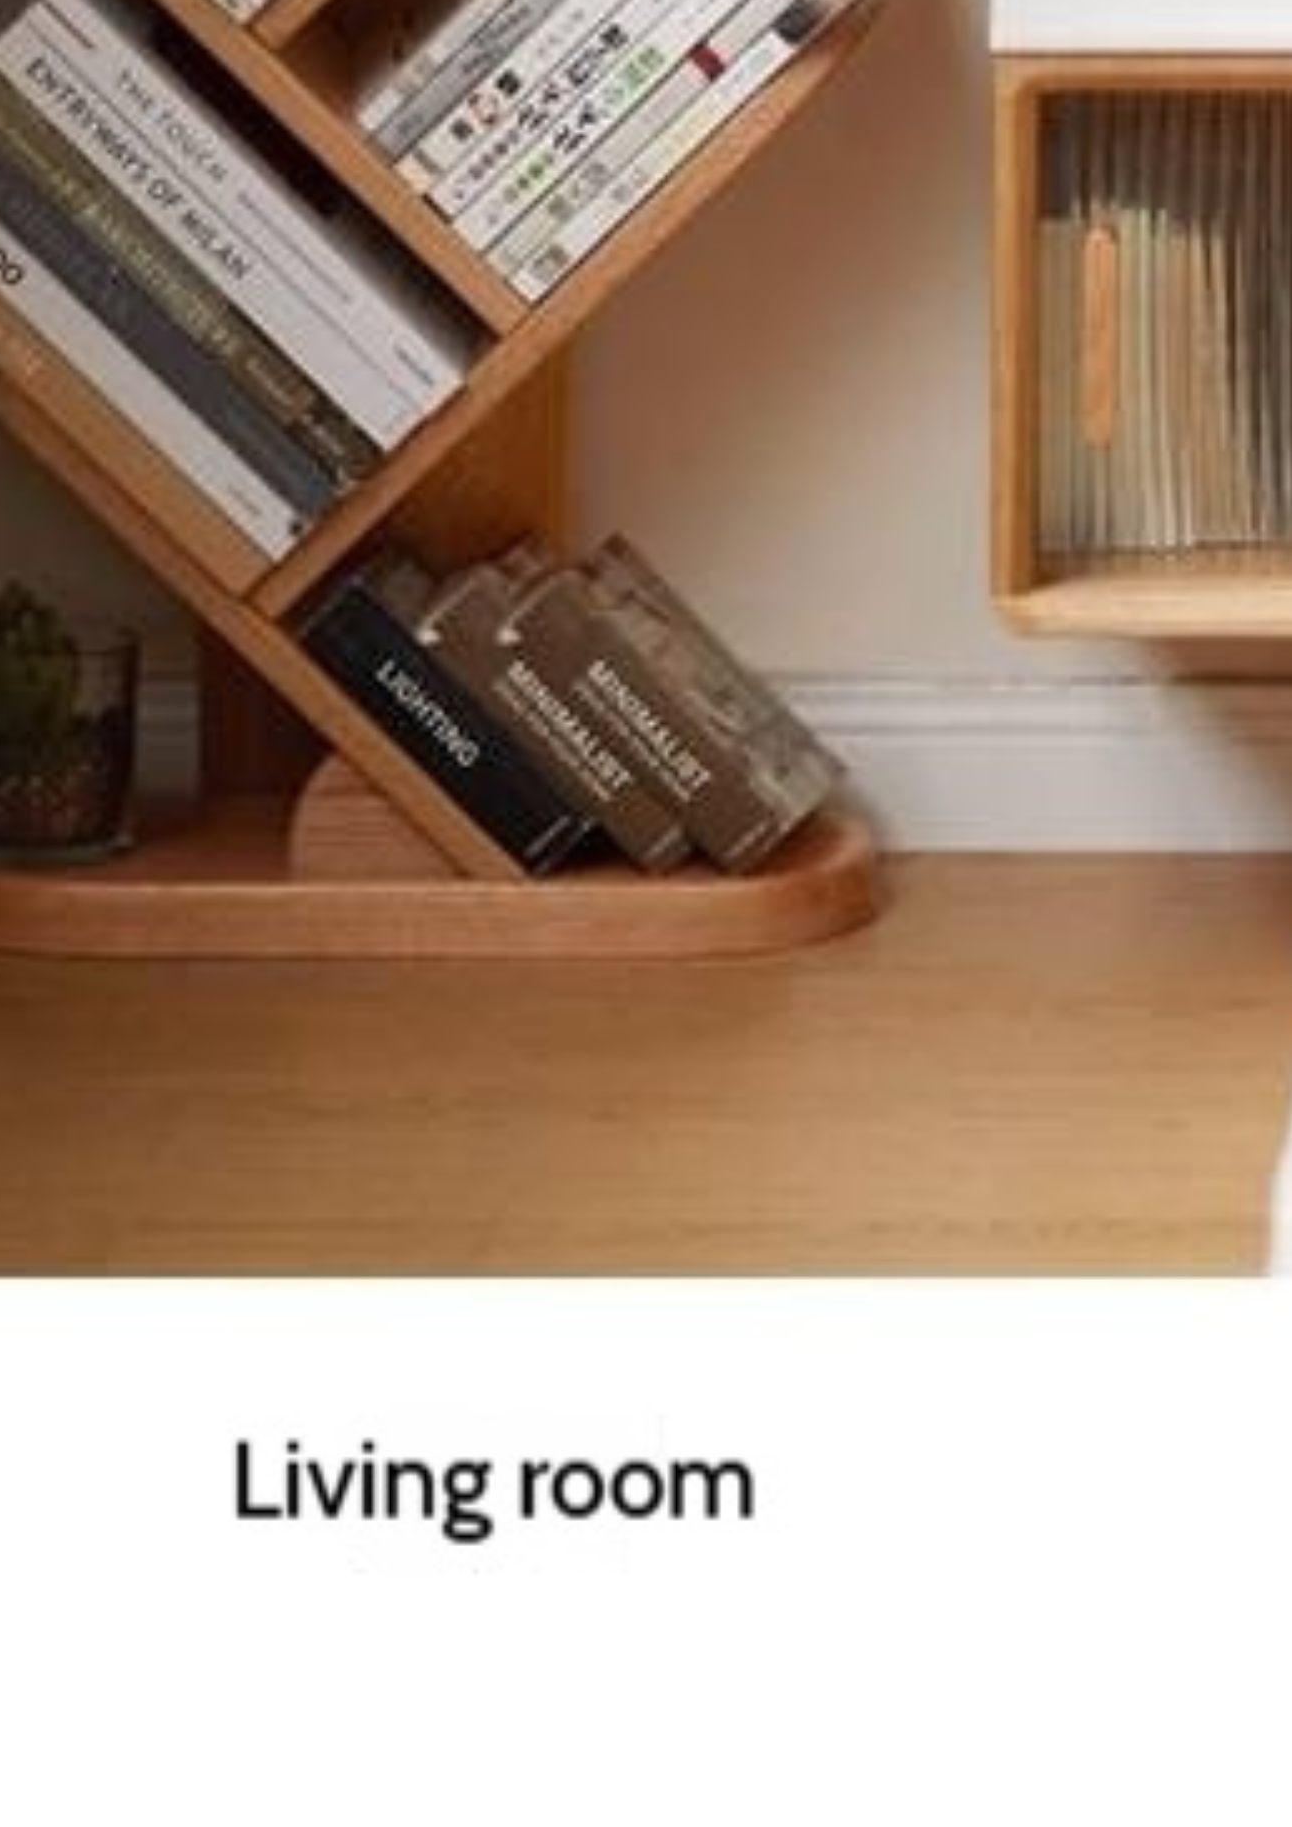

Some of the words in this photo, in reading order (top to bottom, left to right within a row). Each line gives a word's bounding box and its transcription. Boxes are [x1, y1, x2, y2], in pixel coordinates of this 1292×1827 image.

[25, 56, 152, 184] ENTRYWAYS
[146, 177, 184, 210] OF
[180, 208, 253, 282] MILAN
[374, 657, 481, 769] LIGHTING
[505, 658, 634, 789] MINIMALIST
[586, 658, 713, 789] MINIMALIST
